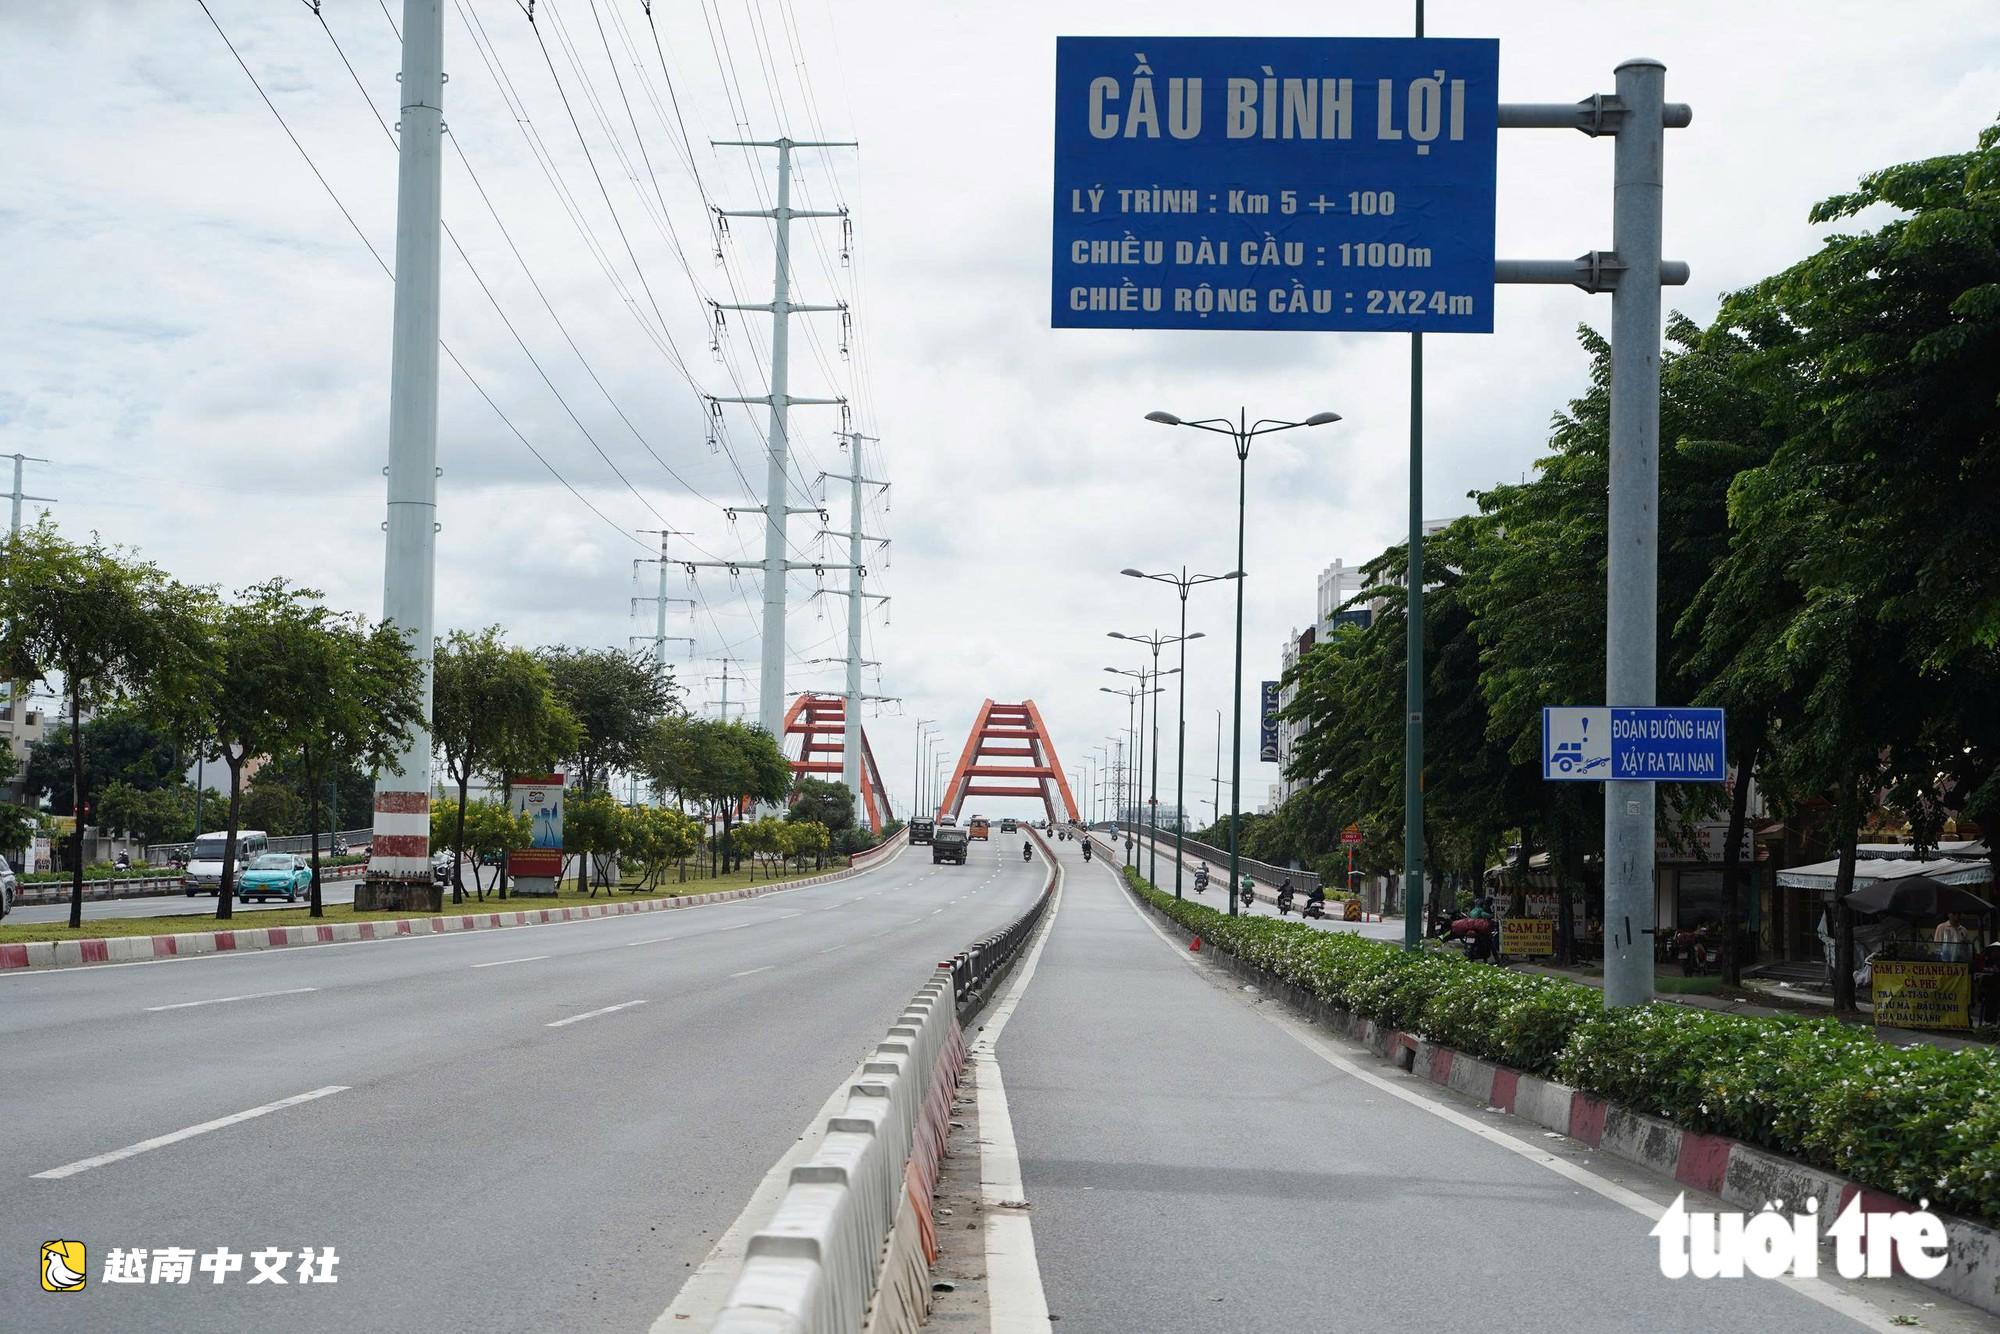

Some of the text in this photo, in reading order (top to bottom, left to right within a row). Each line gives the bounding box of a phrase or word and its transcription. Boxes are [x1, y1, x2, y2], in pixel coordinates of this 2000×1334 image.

[1089, 53, 1465, 155] CẦU BÌNH LỢI
[1072, 184, 1395, 216] LÝ TRÌNH : Km 5 + 100
[1071, 231, 1432, 267] CHIỀU DÀI CẦU : 1100m
[1069, 276, 1473, 317] CHIỀU RỘNG CẦU : 2X24m
[1613, 714, 1720, 741] ĐOẠN ĐƯỜNG HAY
[1621, 746, 1714, 775] XẢY RA TAI NẠN
[1508, 922, 1533, 933] CAM
